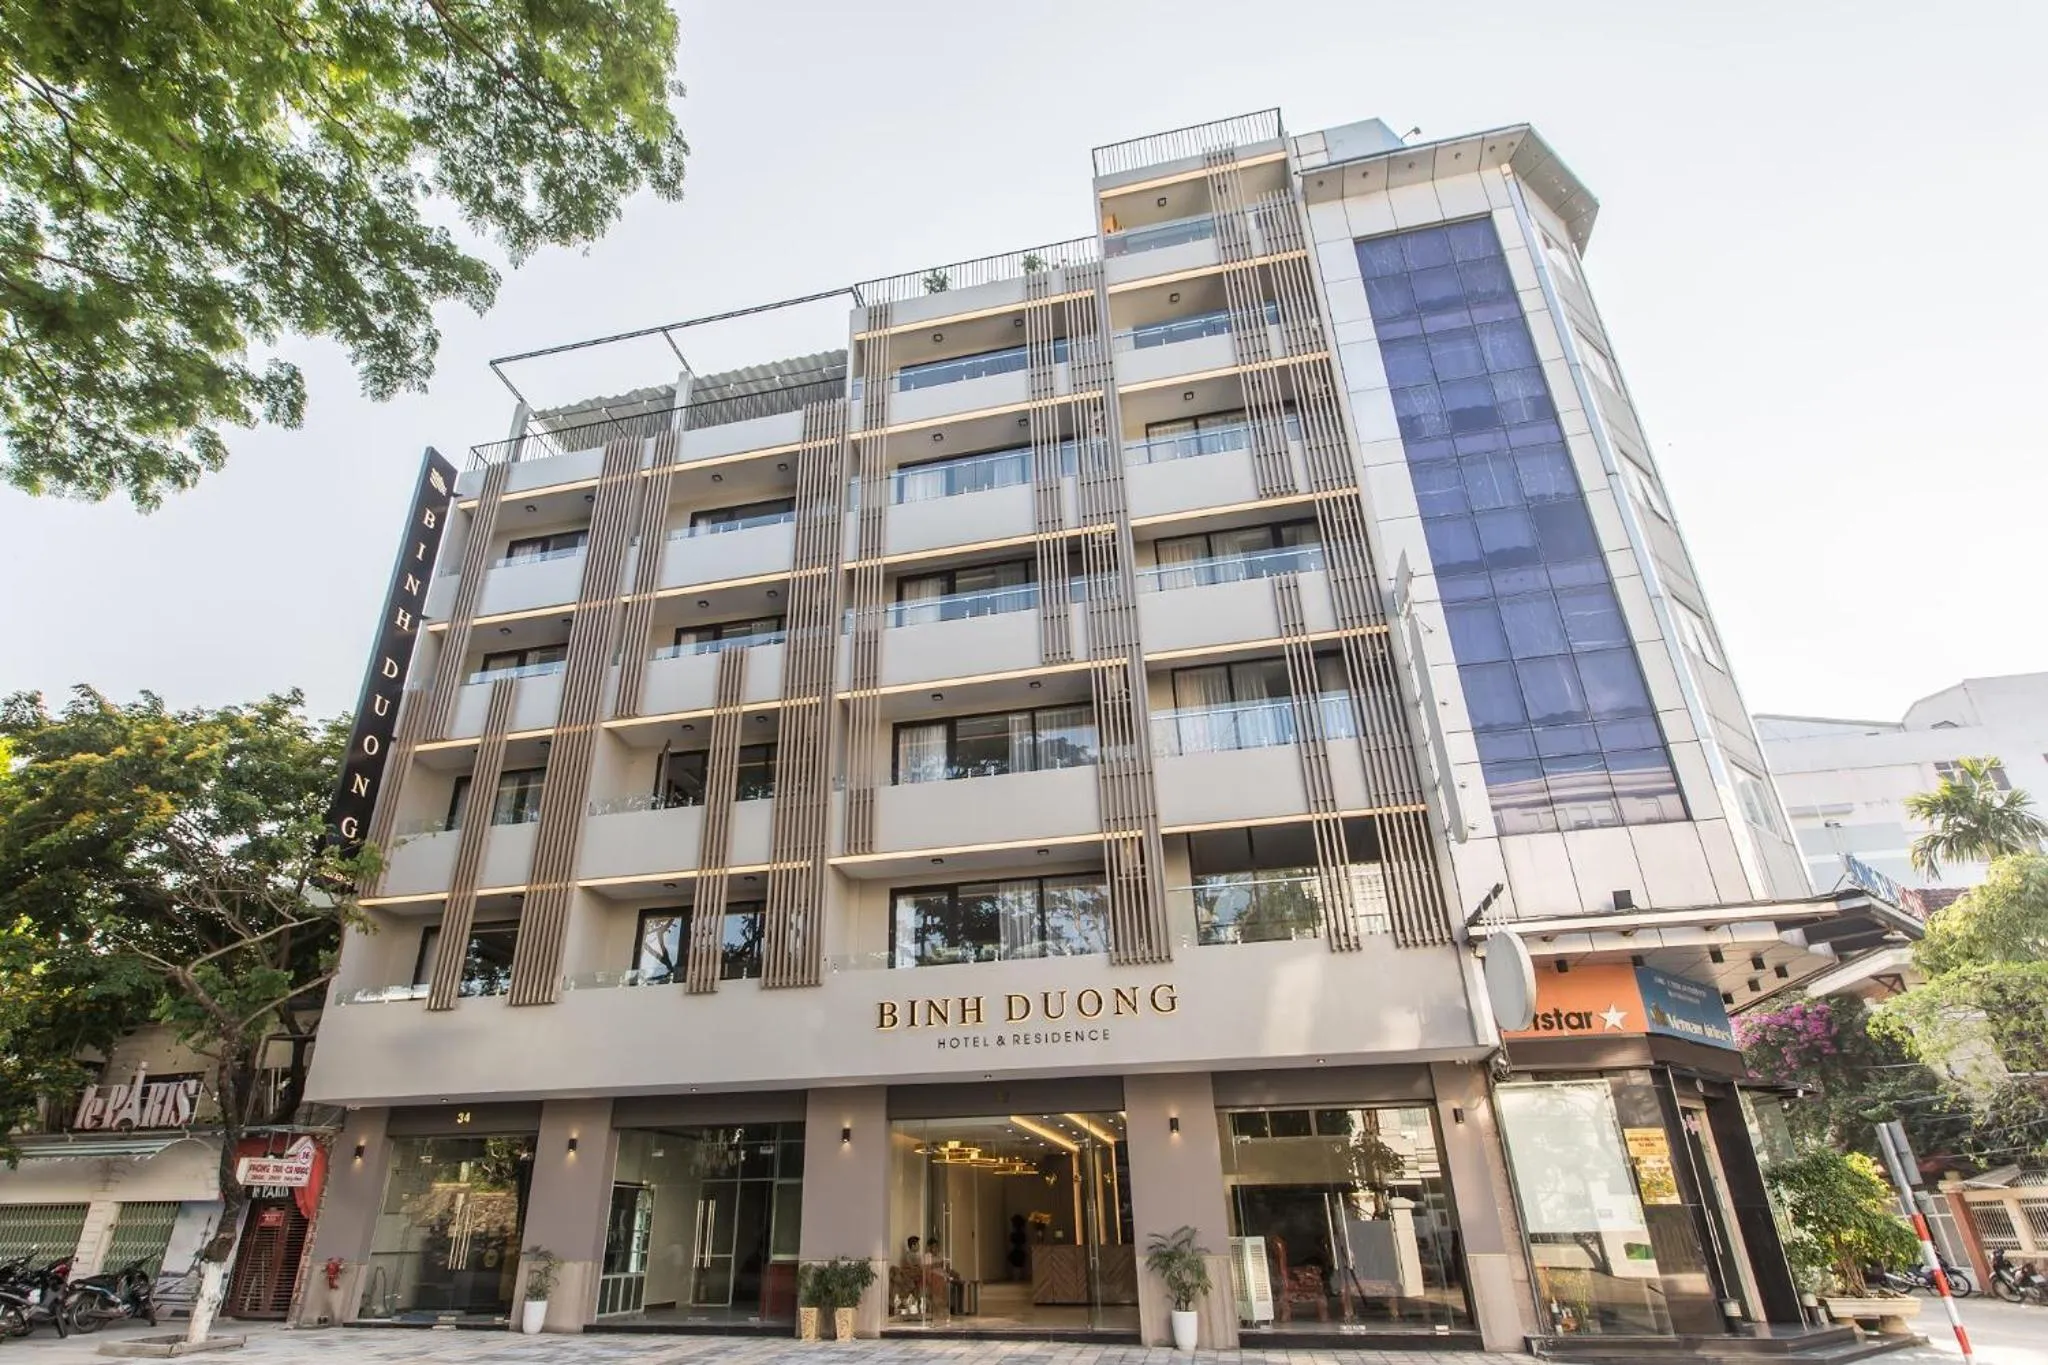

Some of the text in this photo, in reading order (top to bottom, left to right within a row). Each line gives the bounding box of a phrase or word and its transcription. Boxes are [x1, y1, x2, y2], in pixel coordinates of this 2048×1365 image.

[341, 507, 436, 839] BINH DUONG
[875, 984, 1179, 1030] BINH DUONG
[937, 1028, 1111, 1049] HOTEL & RESIDENCE
[457, 1111, 471, 1124] 34
